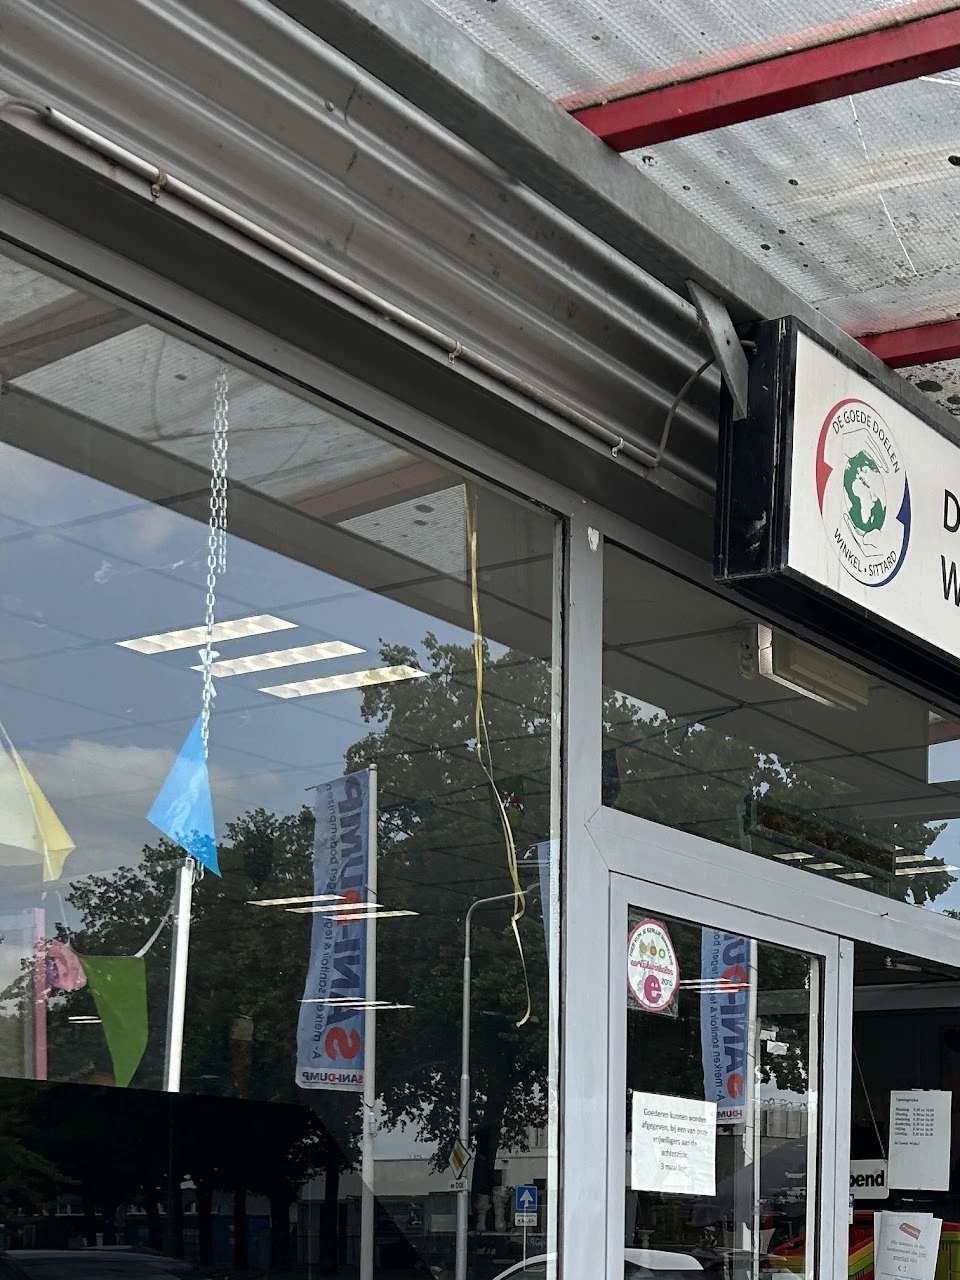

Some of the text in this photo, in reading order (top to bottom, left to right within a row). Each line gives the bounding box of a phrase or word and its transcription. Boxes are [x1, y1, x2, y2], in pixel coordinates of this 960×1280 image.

[832, 409, 900, 474] DE GOEDE DOELEN
[833, 527, 897, 577] WINKEL SITTARD
[643, 1108, 707, 1123] Goederen kunnen worden
